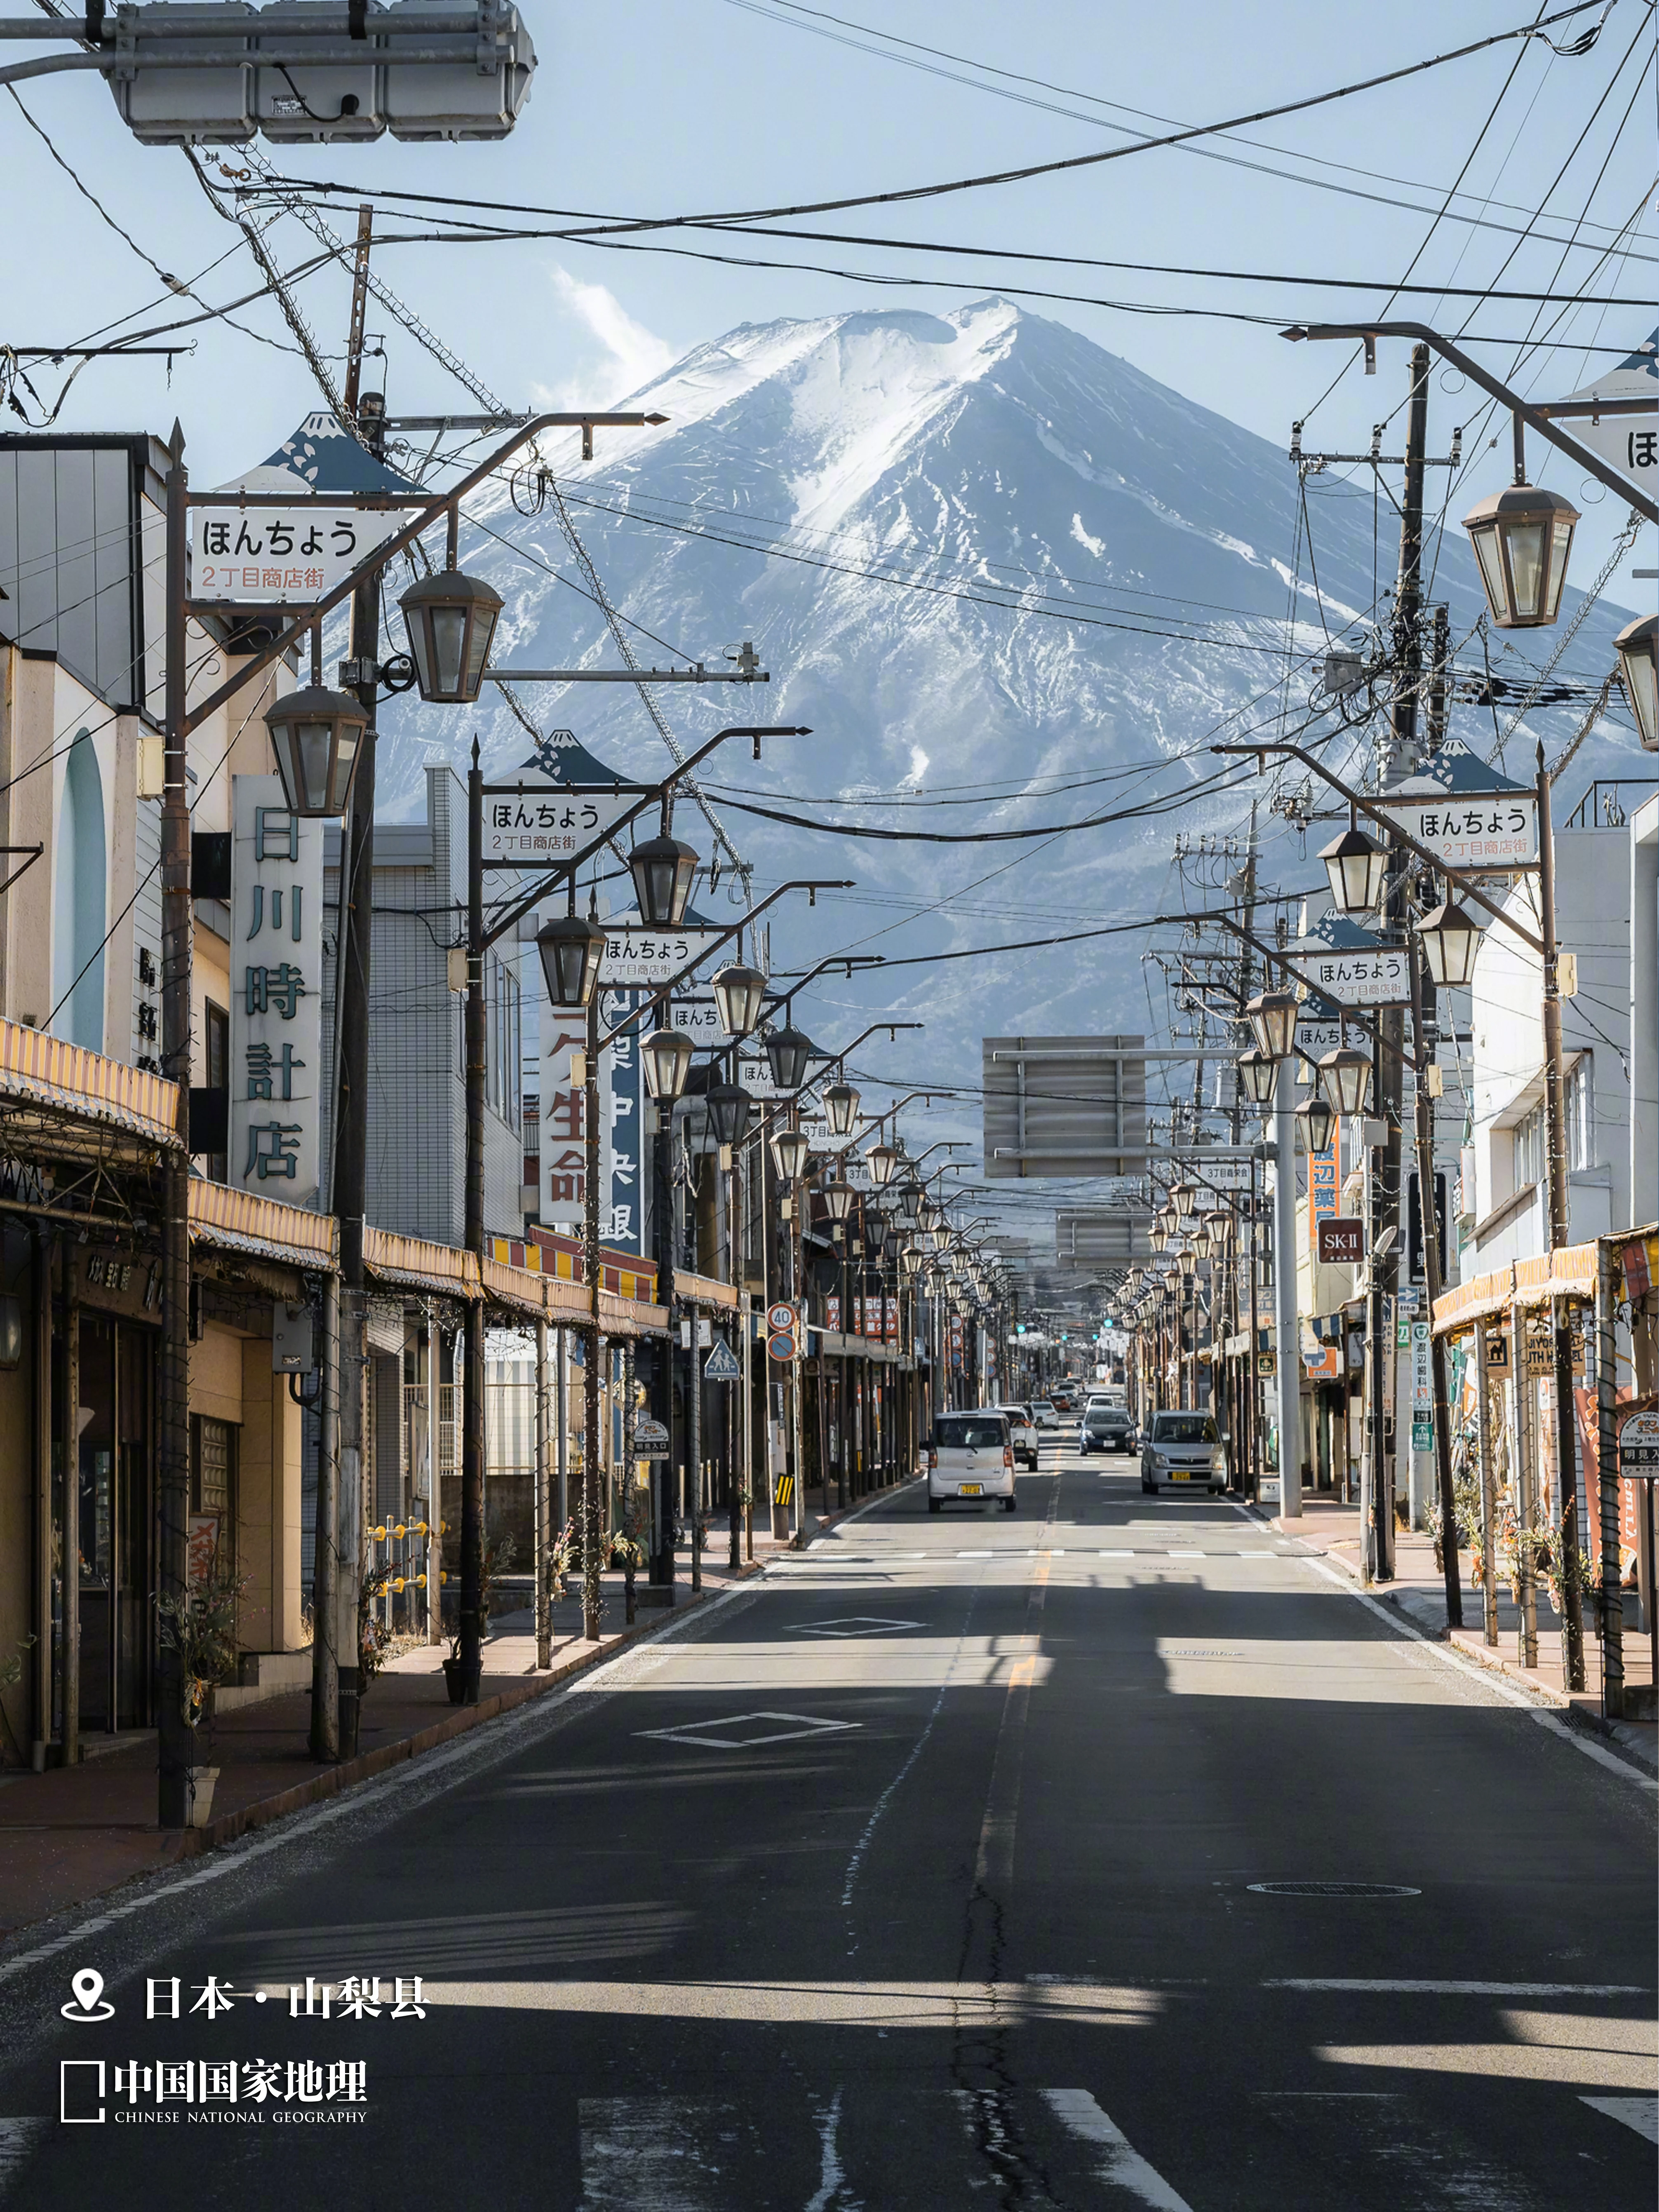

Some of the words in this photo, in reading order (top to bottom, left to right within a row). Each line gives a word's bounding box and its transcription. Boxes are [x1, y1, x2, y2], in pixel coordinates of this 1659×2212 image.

[1628, 431, 1658, 468] ほ
[204, 520, 356, 557] ほんちょう
[202, 566, 324, 589] 2丁目商店街
[493, 804, 598, 829] ほんちょう
[1420, 808, 1525, 837] ほんちょう
[493, 835, 576, 850] 2丁目商店街
[1443, 838, 1527, 857] 2丁目商店街
[606, 940, 688, 960] ほんちょう
[606, 964, 671, 975] 2丁目商店街
[1321, 959, 1400, 982] ほんちょう
[244, 807, 306, 1180] 日川時計店
[1338, 983, 1401, 997] 2丁目商店街
[675, 1010, 721, 1026] ほんち
[1324, 1234, 1358, 1249] SK-II
[774, 1311, 790, 1323] 40
